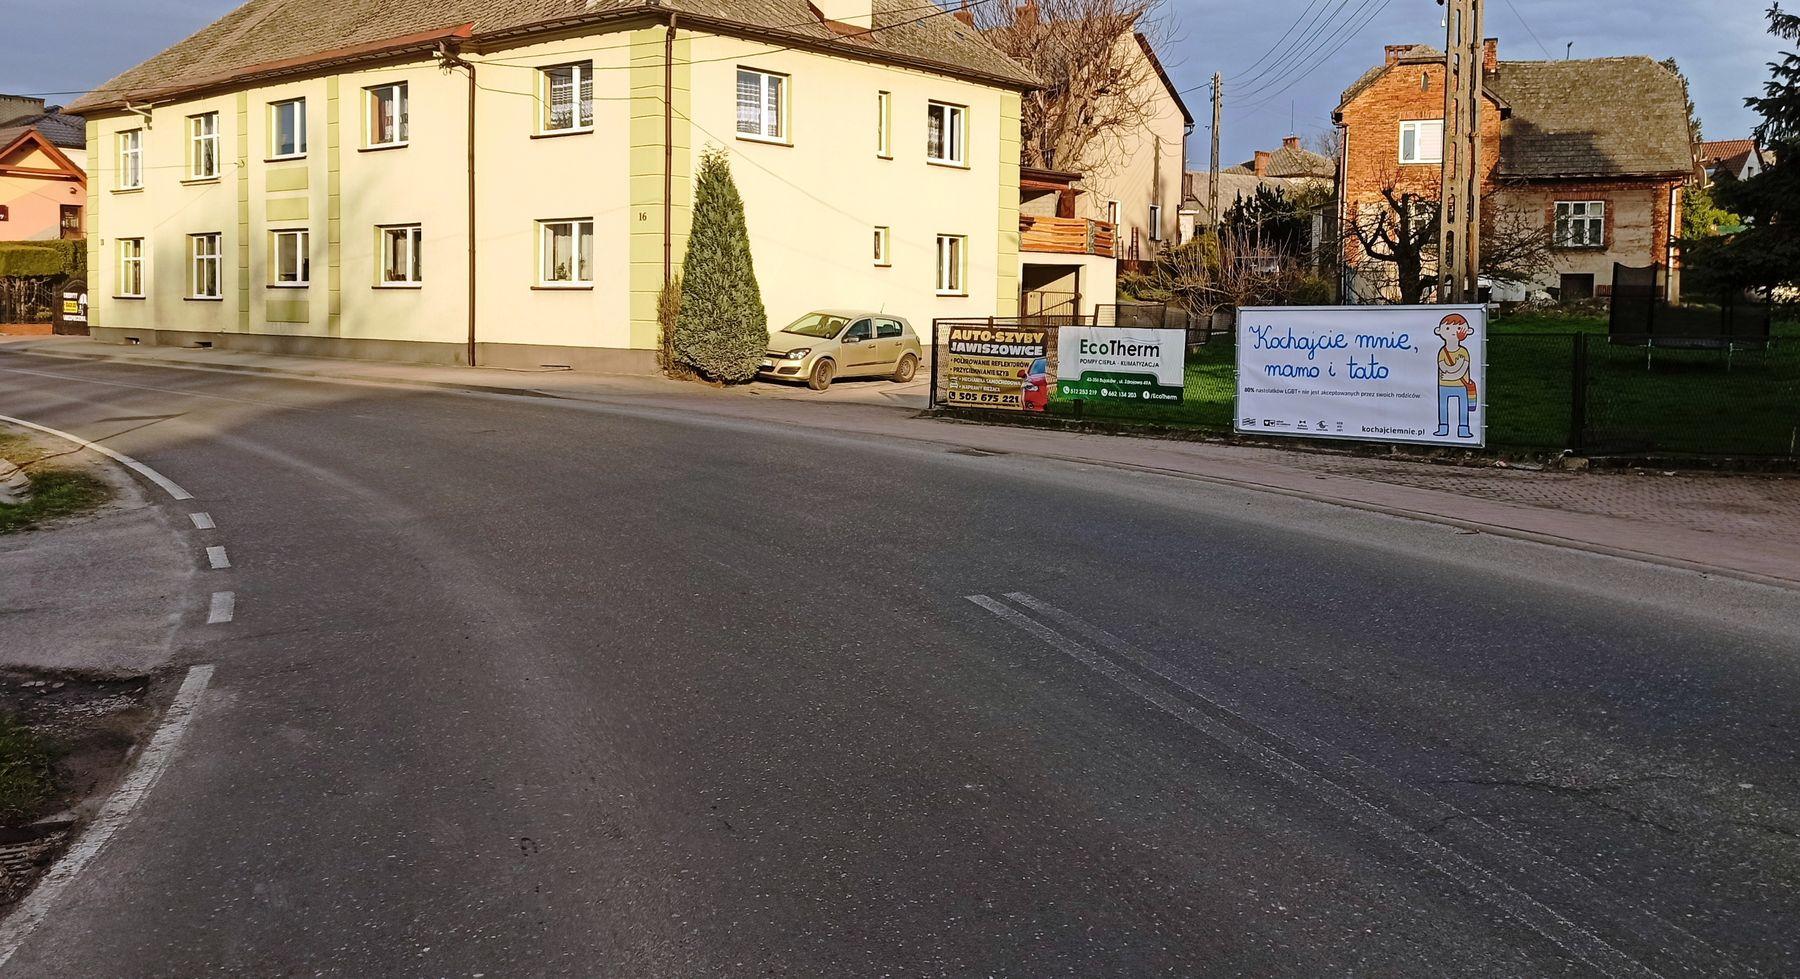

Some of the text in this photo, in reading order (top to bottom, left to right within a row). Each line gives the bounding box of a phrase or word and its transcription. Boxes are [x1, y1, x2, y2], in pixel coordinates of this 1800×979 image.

[639, 212, 647, 221] 16
[1080, 339, 1160, 357] EcoTherm
[1249, 325, 1418, 360] Kochajcie mnie,
[951, 342, 1043, 356] JAWISZOWICE
[991, 360, 1029, 368] REFLEKTORÓW
[1120, 360, 1160, 368] KLIMATYZACJA
[1265, 354, 1389, 380] mamo i tato
[959, 392, 1019, 403] 505 675 221
[1361, 425, 1425, 436] kochajciemnie.pl
